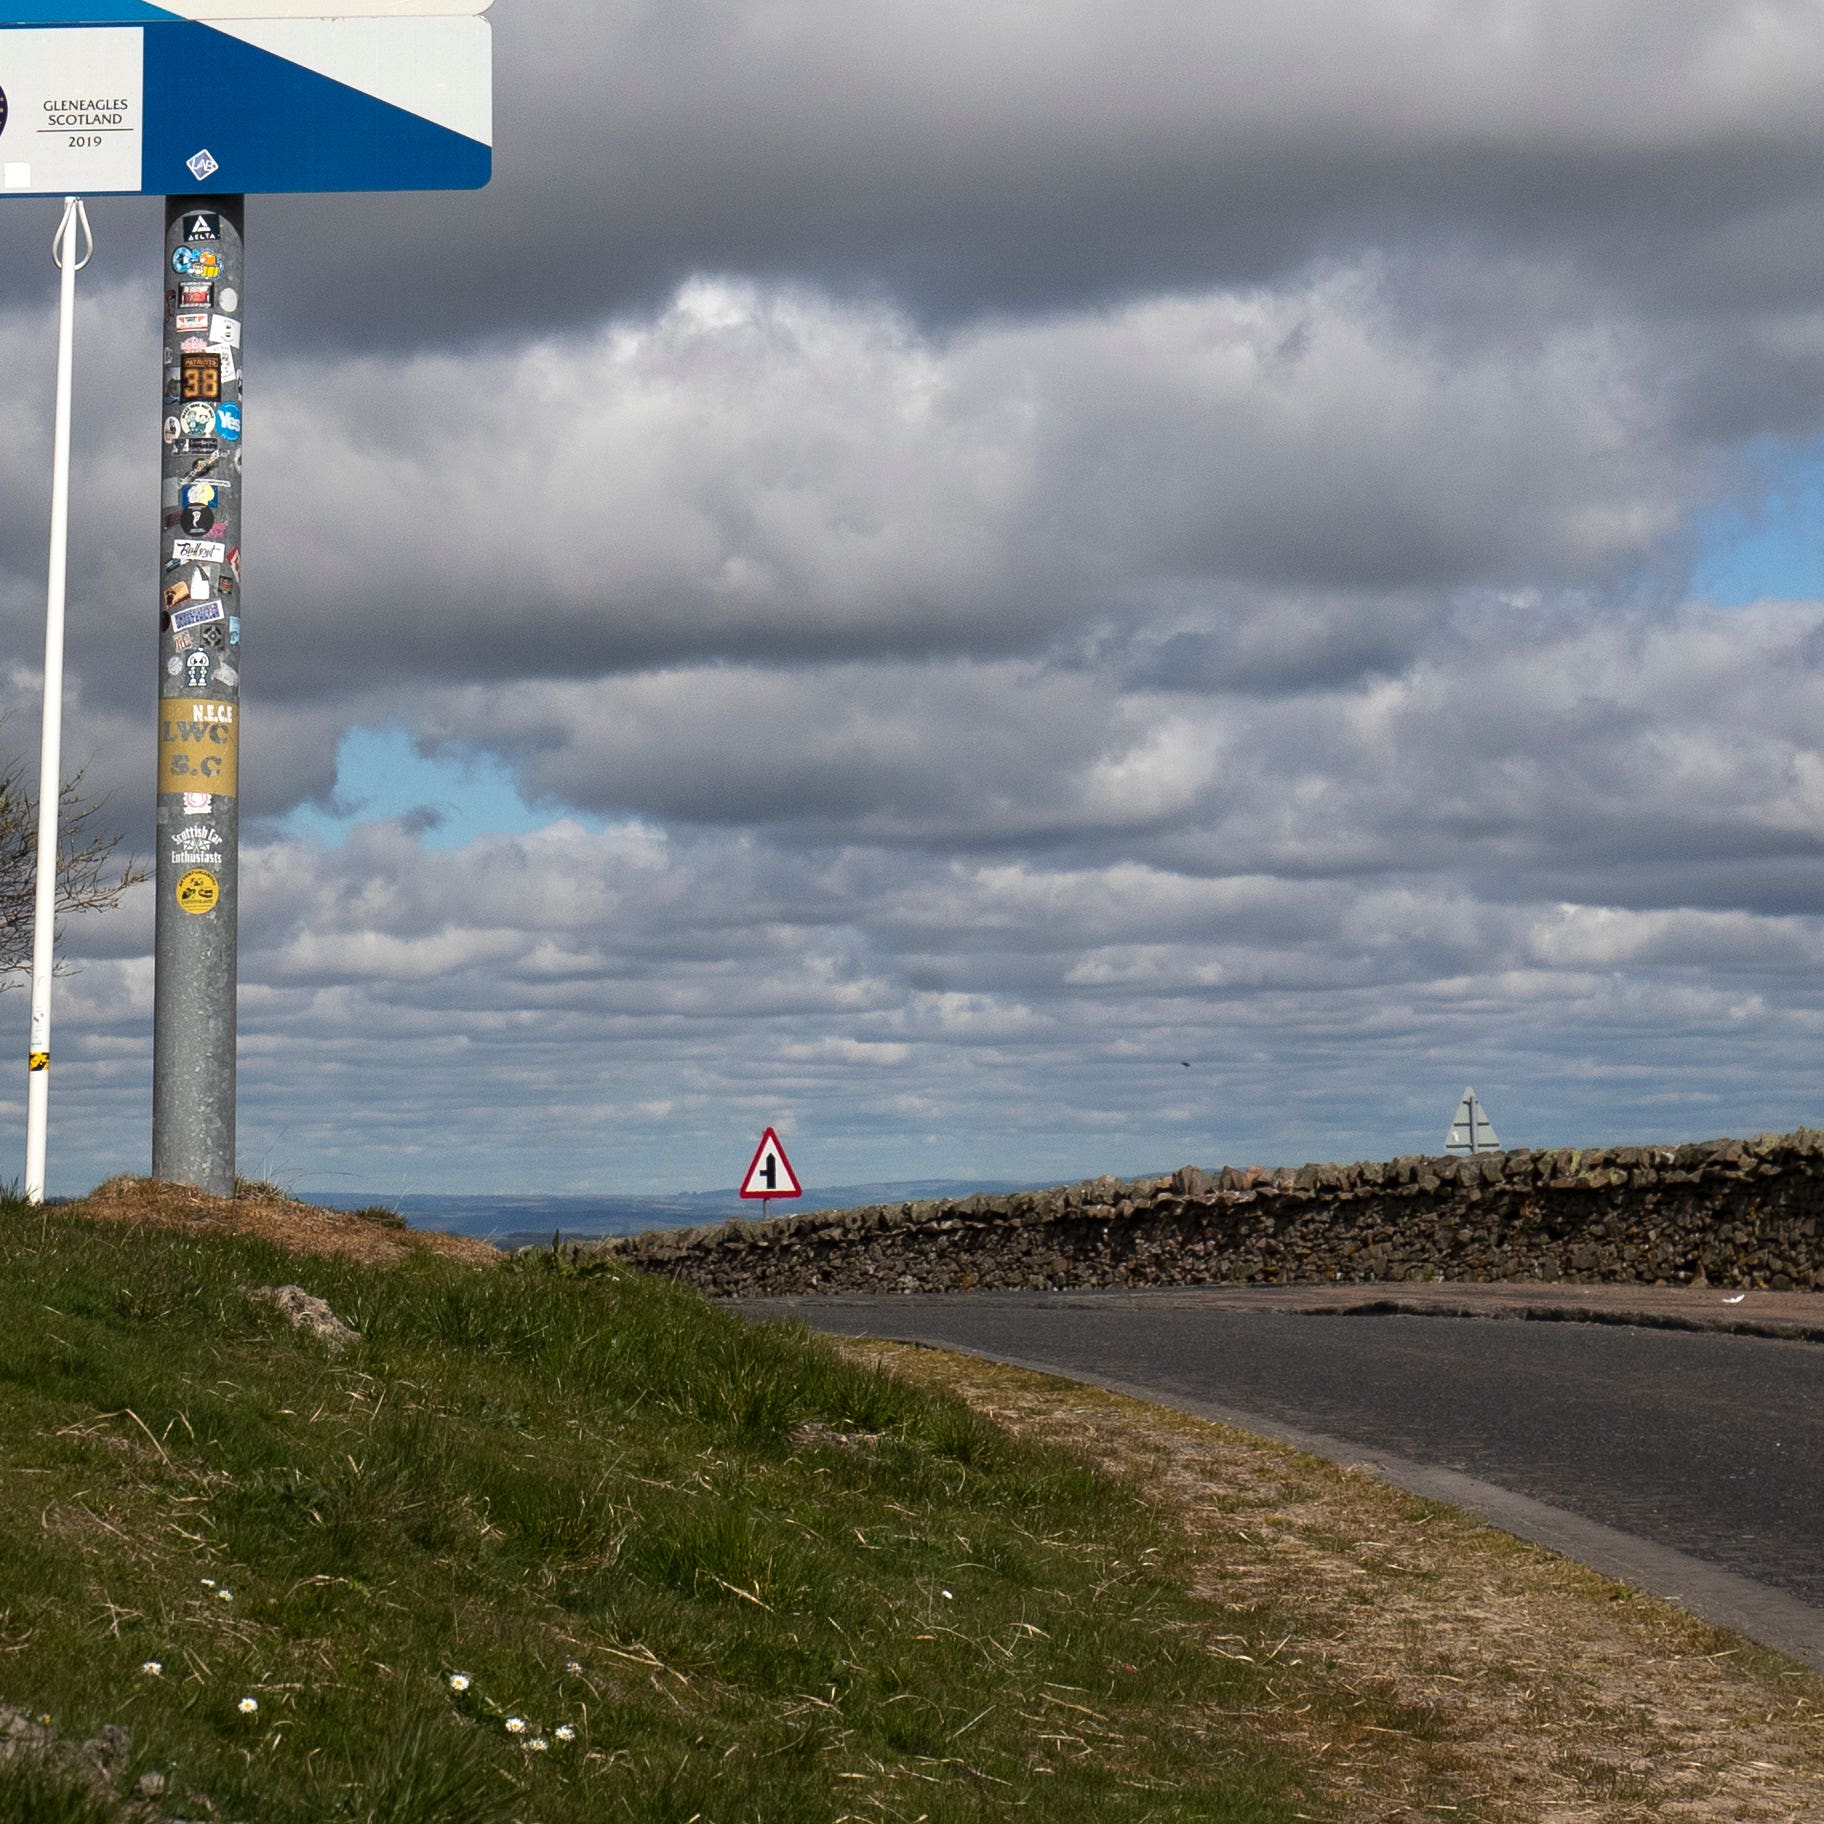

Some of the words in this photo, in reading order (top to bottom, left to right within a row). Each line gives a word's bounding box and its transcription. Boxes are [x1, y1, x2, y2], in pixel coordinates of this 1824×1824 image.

[43, 99, 128, 112] GLENEAGLES
[48, 114, 123, 126] SCOTLAND
[68, 136, 102, 148] 2019
[184, 369, 218, 398] 38
[163, 720, 229, 744] LWC
[171, 825, 207, 845] Scottish
[208, 828, 223, 845] Car
[171, 850, 223, 864] Enthusiasts
